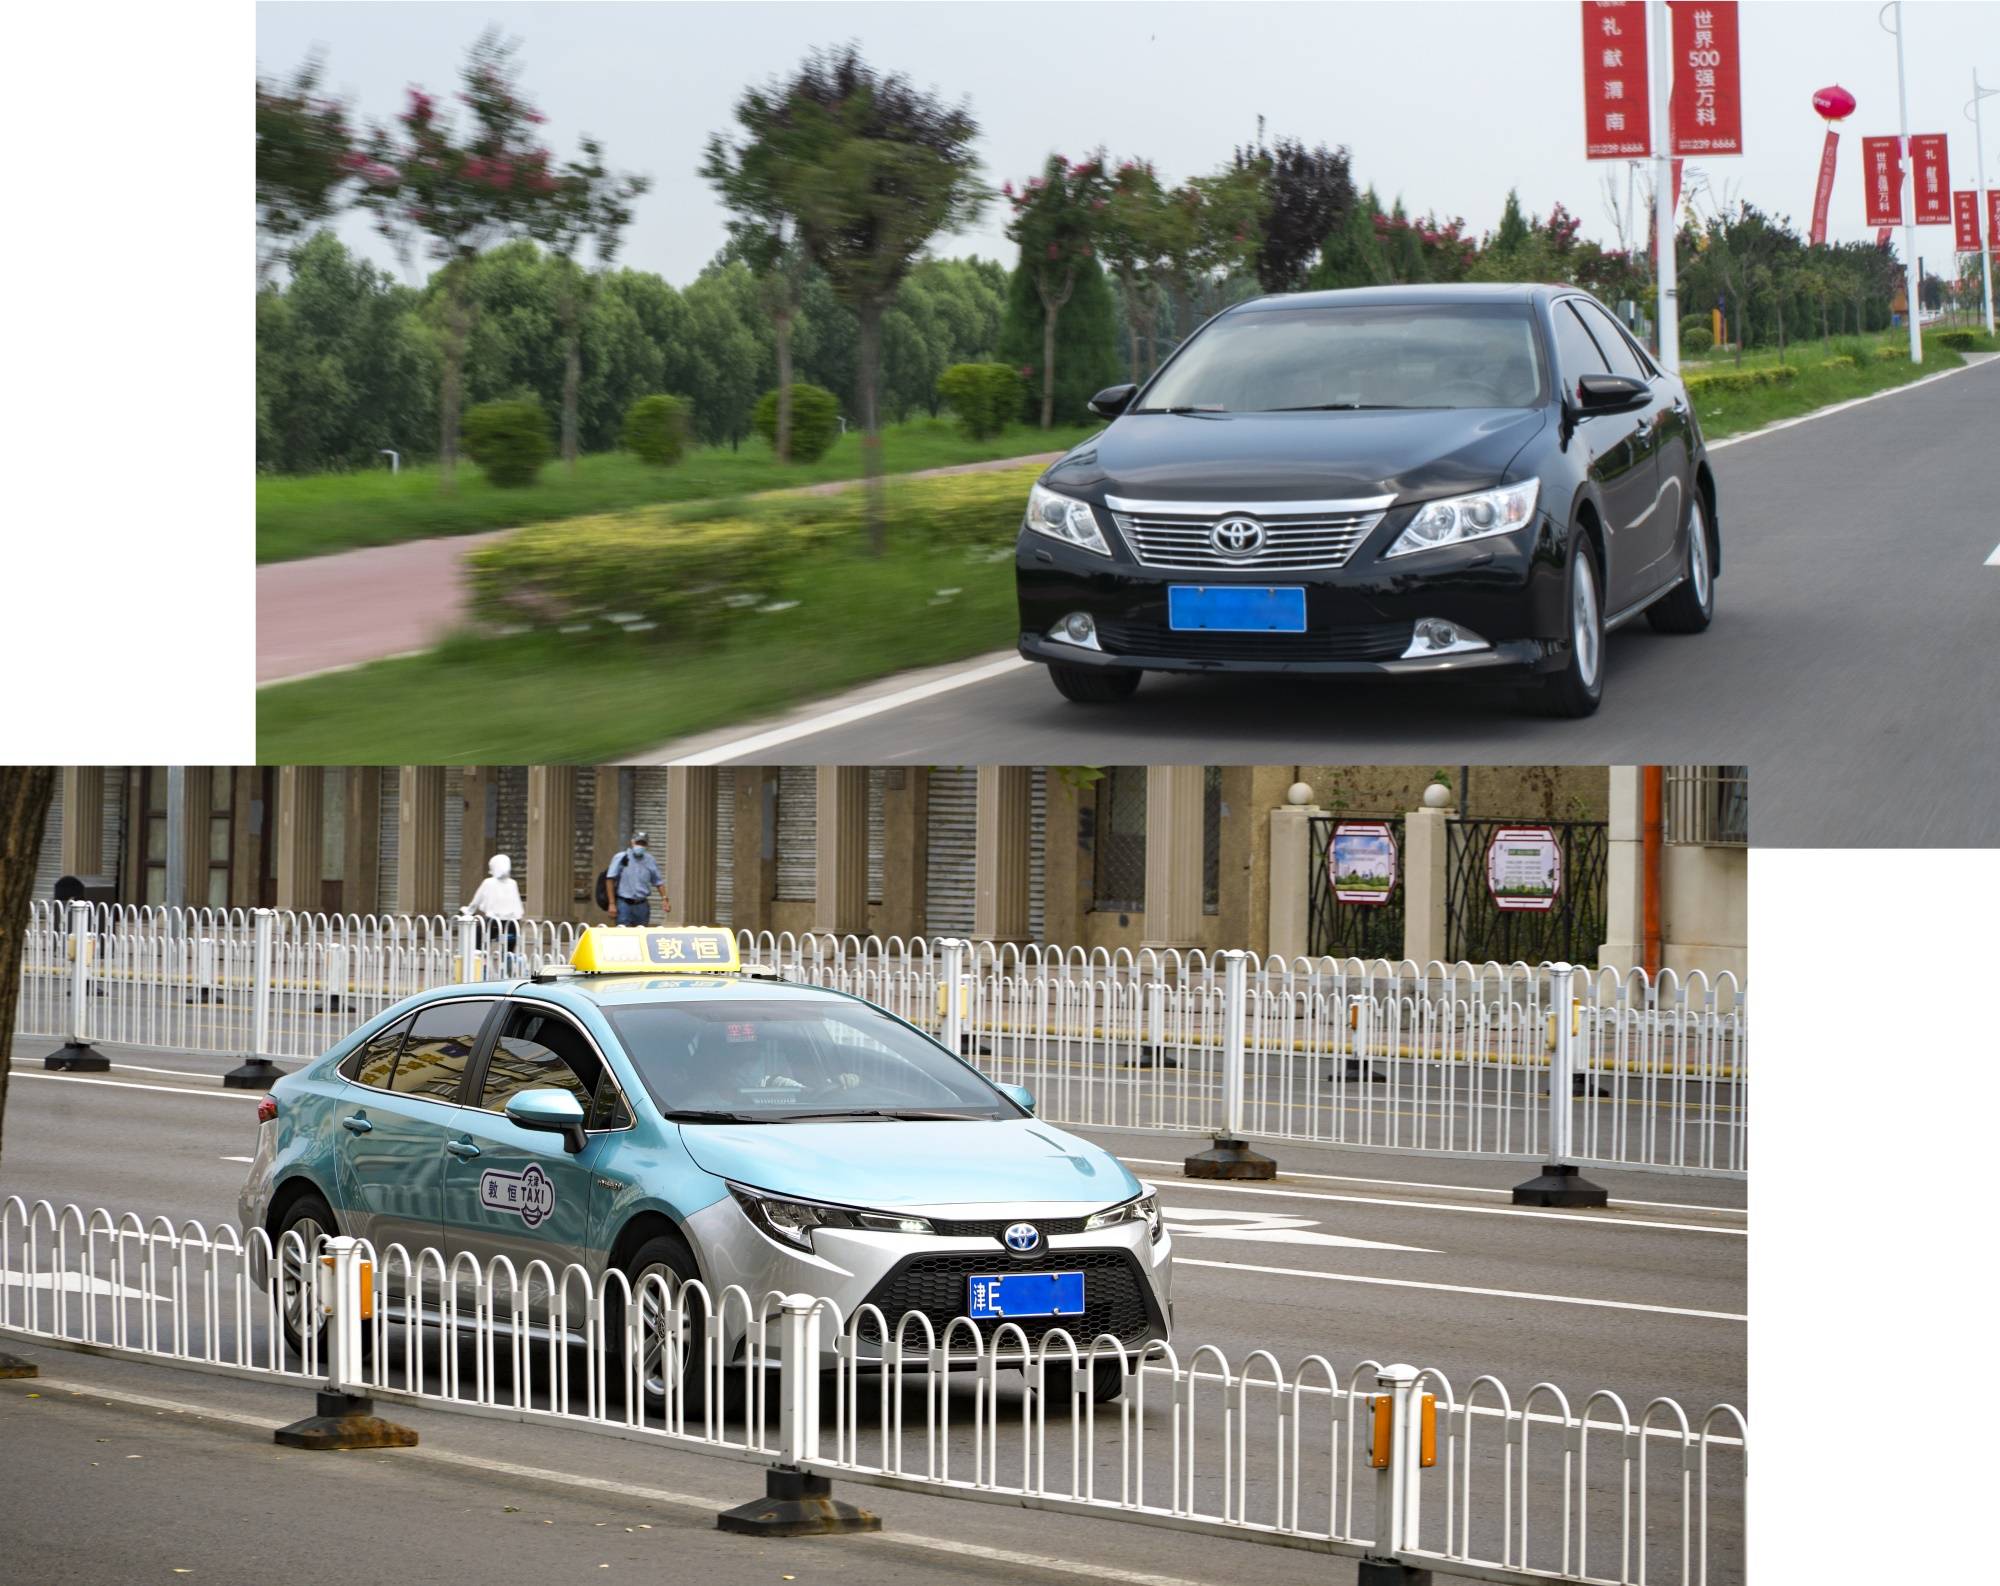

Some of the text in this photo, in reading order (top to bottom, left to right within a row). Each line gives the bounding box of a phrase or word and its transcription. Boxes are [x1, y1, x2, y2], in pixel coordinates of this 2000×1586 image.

[655, 937, 721, 960] 敦恒
[488, 1180, 517, 1202] 敦恒
[520, 1186, 545, 1204] TAXI
[973, 1281, 1002, 1313] 津E
